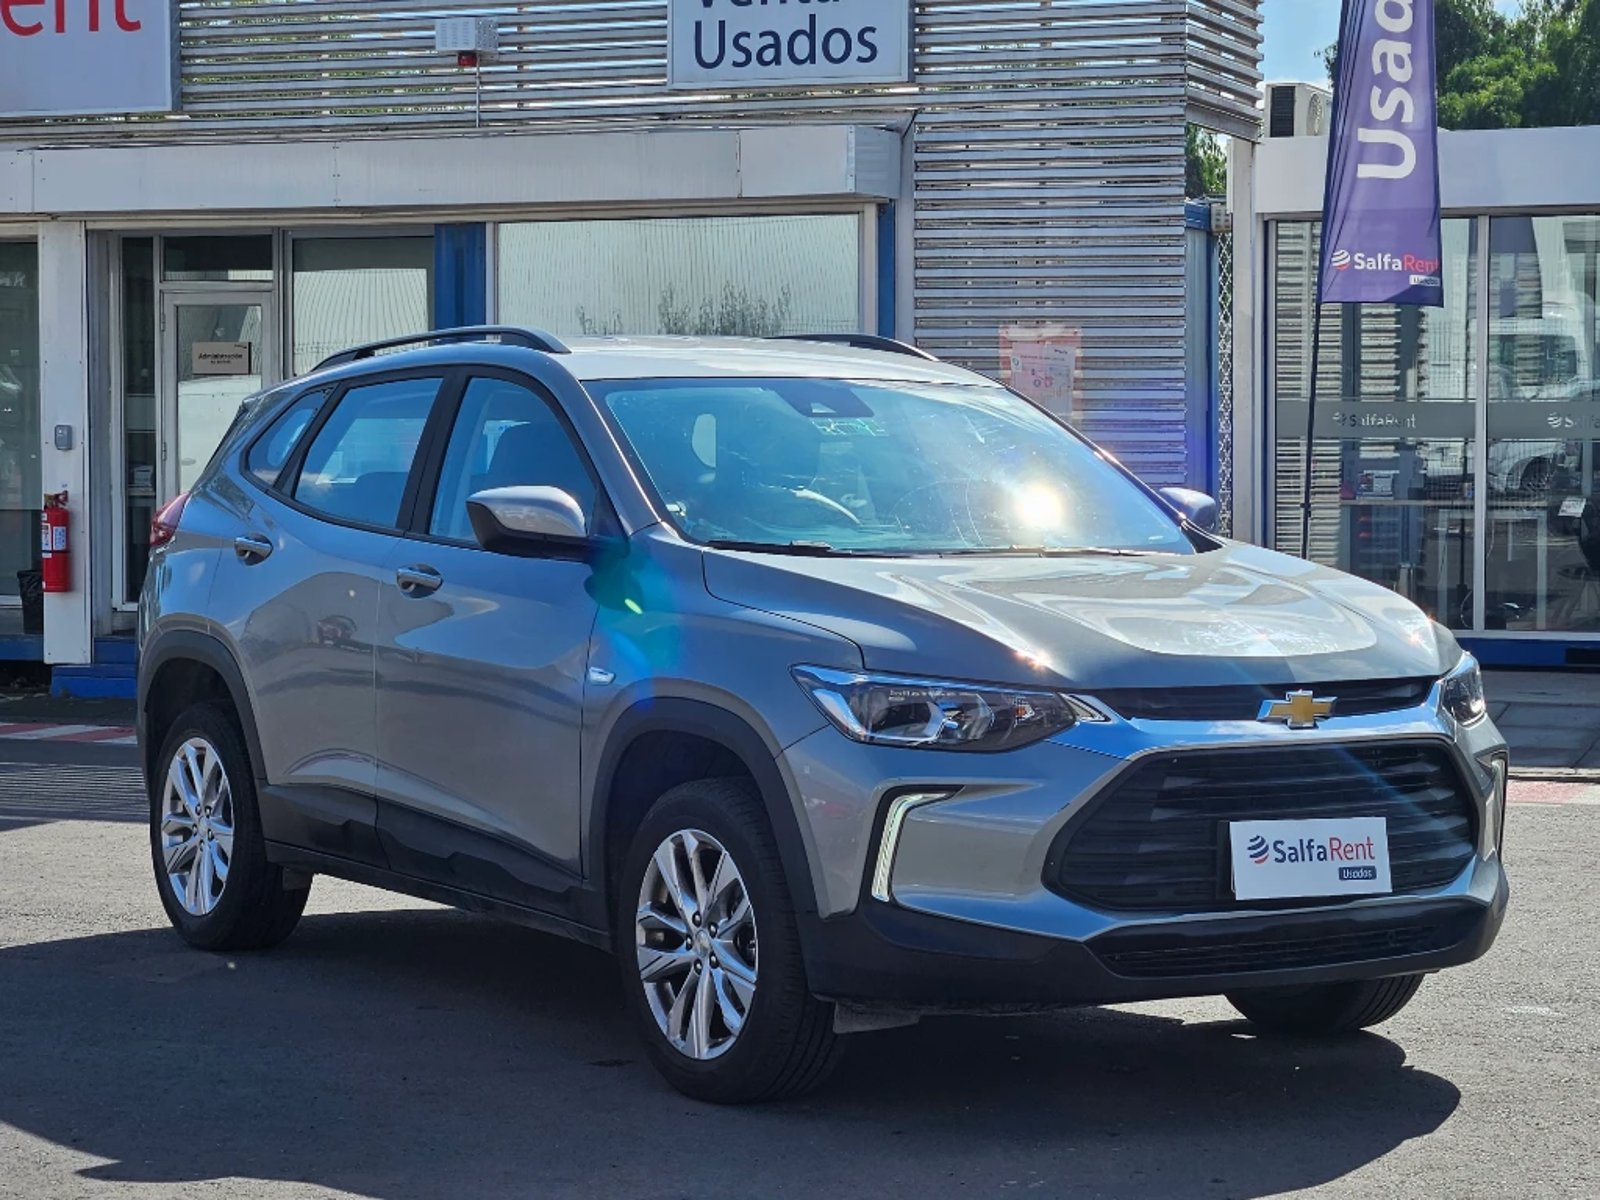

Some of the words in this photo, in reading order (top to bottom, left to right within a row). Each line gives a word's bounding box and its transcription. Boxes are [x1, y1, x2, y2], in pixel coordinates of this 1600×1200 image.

[694, 13, 878, 70] Usados
[1272, 835, 1376, 864] SalfaRent
[1342, 867, 1373, 880] Usados
